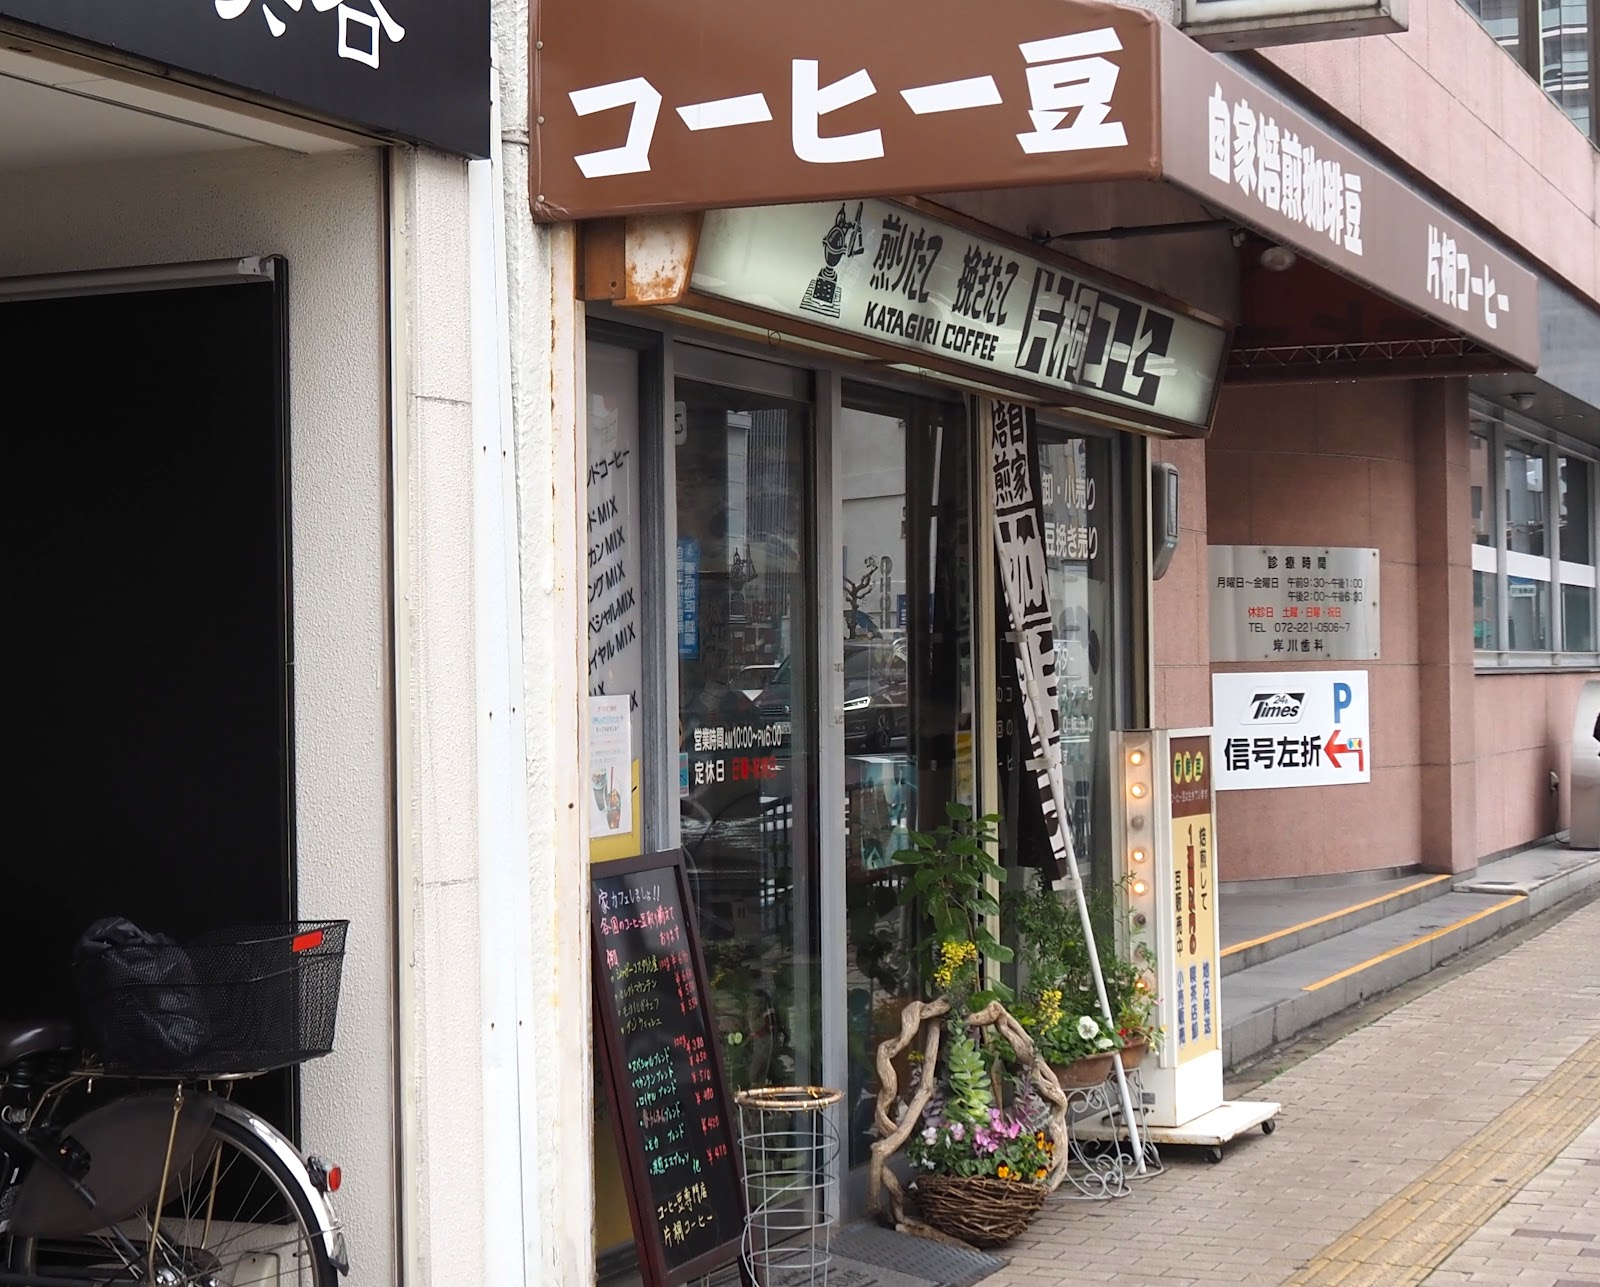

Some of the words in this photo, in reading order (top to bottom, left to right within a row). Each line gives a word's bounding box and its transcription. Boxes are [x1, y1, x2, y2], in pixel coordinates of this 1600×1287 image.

[568, 27, 1128, 178] コーヒー豆
[1209, 81, 1363, 256] 自家焙煎珈琲豆
[869, 213, 943, 303] 煎りたて
[952, 244, 1019, 326] 挽きたて
[1427, 224, 1509, 329] 片桐コーヒー
[864, 301, 941, 345] KATAGIRI
[942, 324, 999, 362] COFFEE
[1015, 267, 1175, 406] 片桐コーヒー
[1044, 522, 1098, 559] 豆挽き売り
[1268, 556, 1327, 570] 診療時間
[1248, 607, 1274, 618] 休診日
[1249, 622, 1266, 633] TEL
[1273, 639, 1324, 653] 岸川歯科
[1251, 693, 1305, 719] Times
[1333, 683, 1352, 723] P
[1224, 735, 1322, 771] 信号左折
[694, 760, 725, 785] 定休日
[659, 926, 680, 946] おります
[1202, 962, 1212, 1035] 地方発送
[658, 1182, 708, 1220] コーヒー豆専門店
[663, 1215, 713, 1248] 片桐コーヒー
